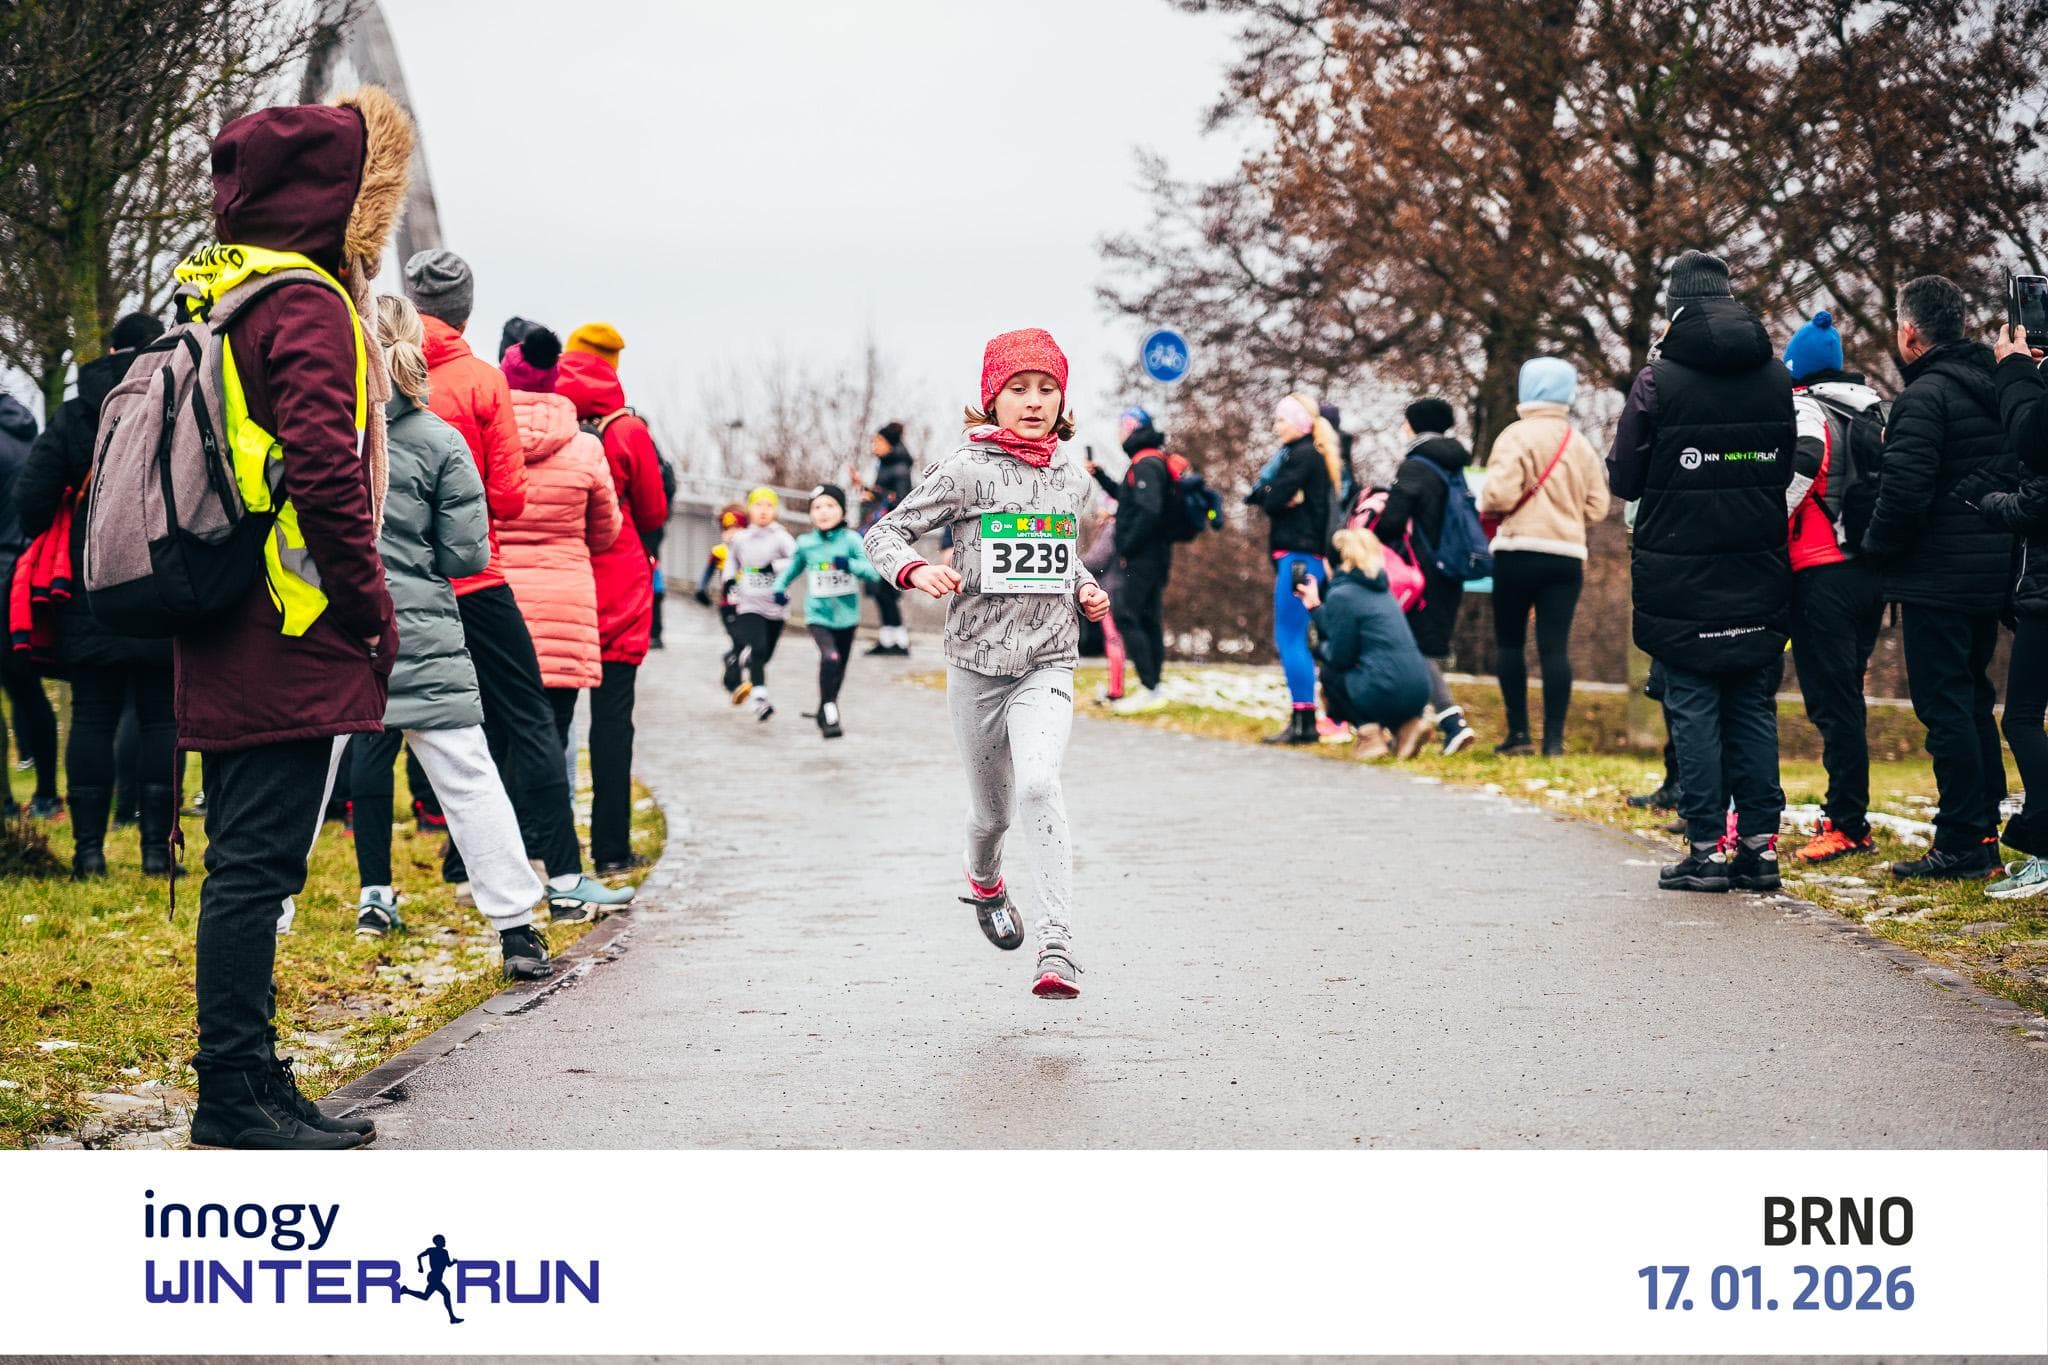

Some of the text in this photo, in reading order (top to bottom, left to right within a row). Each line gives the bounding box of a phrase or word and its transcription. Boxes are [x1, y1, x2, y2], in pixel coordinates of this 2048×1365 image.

[1704, 453, 1720, 461] NN
[993, 543, 1068, 573] 3239
[1050, 687, 1071, 703] PUMA
